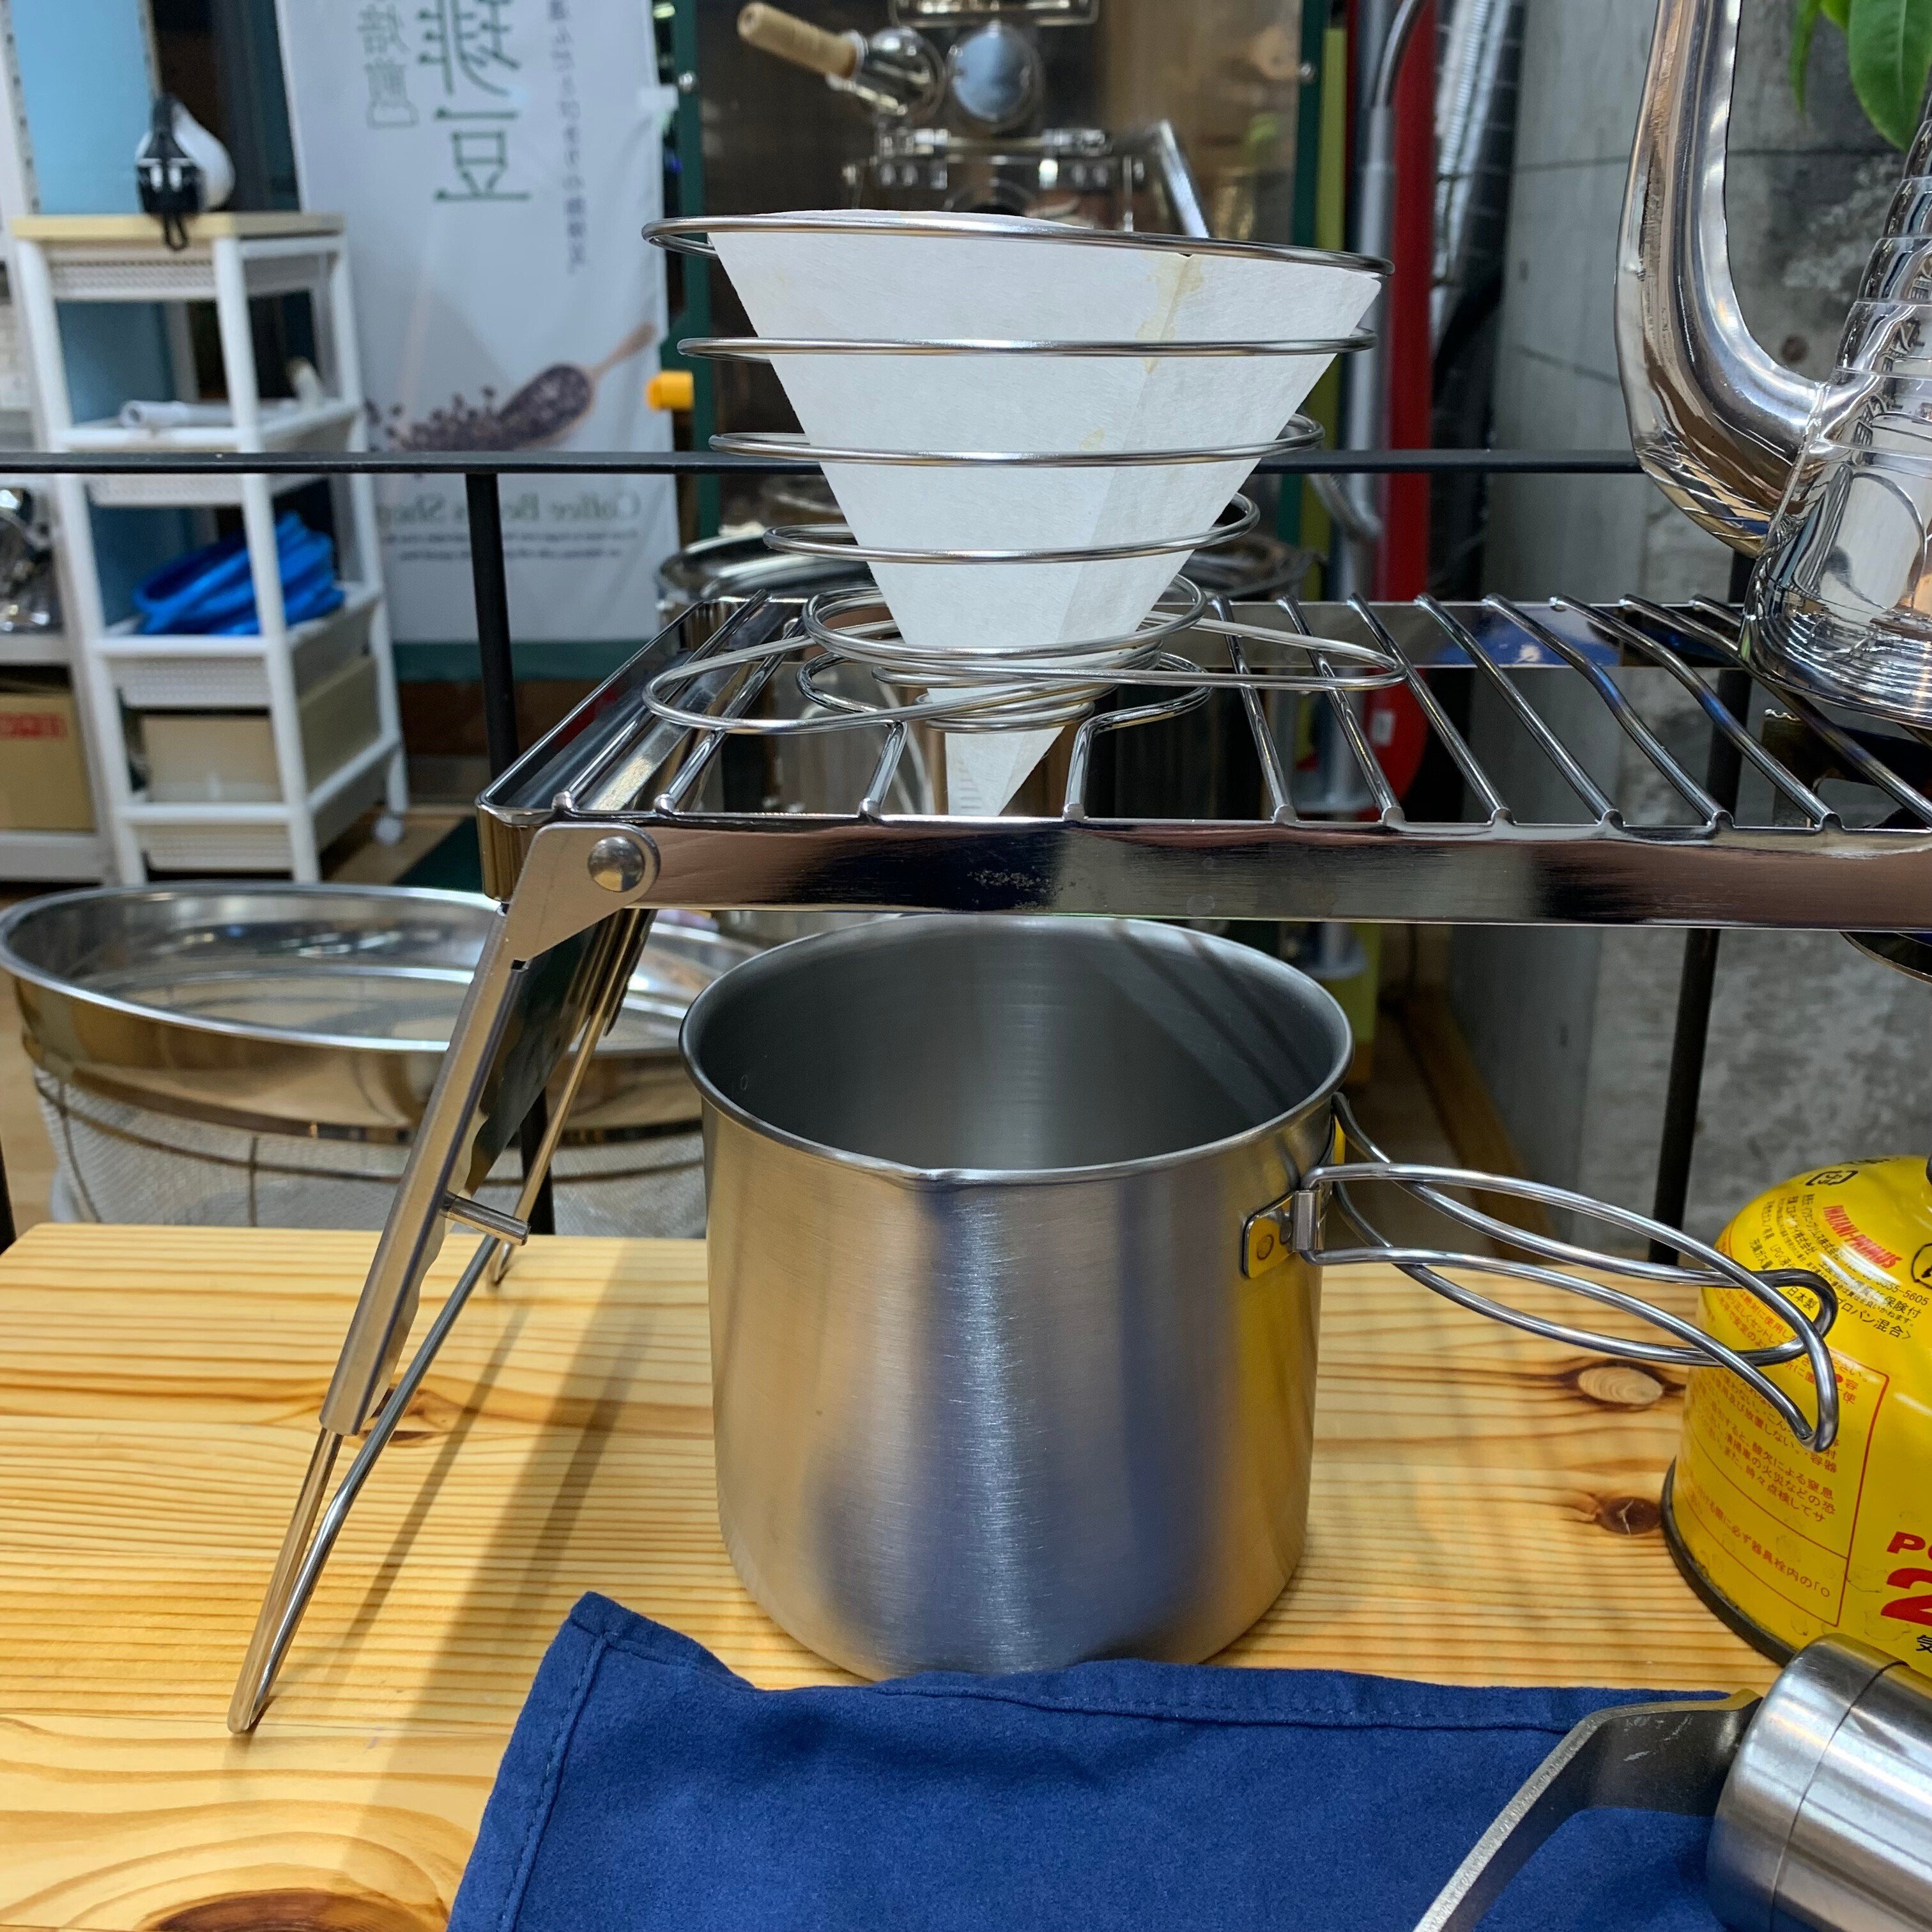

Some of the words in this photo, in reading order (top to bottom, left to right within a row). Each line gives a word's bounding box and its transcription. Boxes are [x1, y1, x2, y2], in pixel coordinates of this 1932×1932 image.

[1787, 1286, 1818, 1311] 日本製
[1887, 1531, 1932, 1561] P
